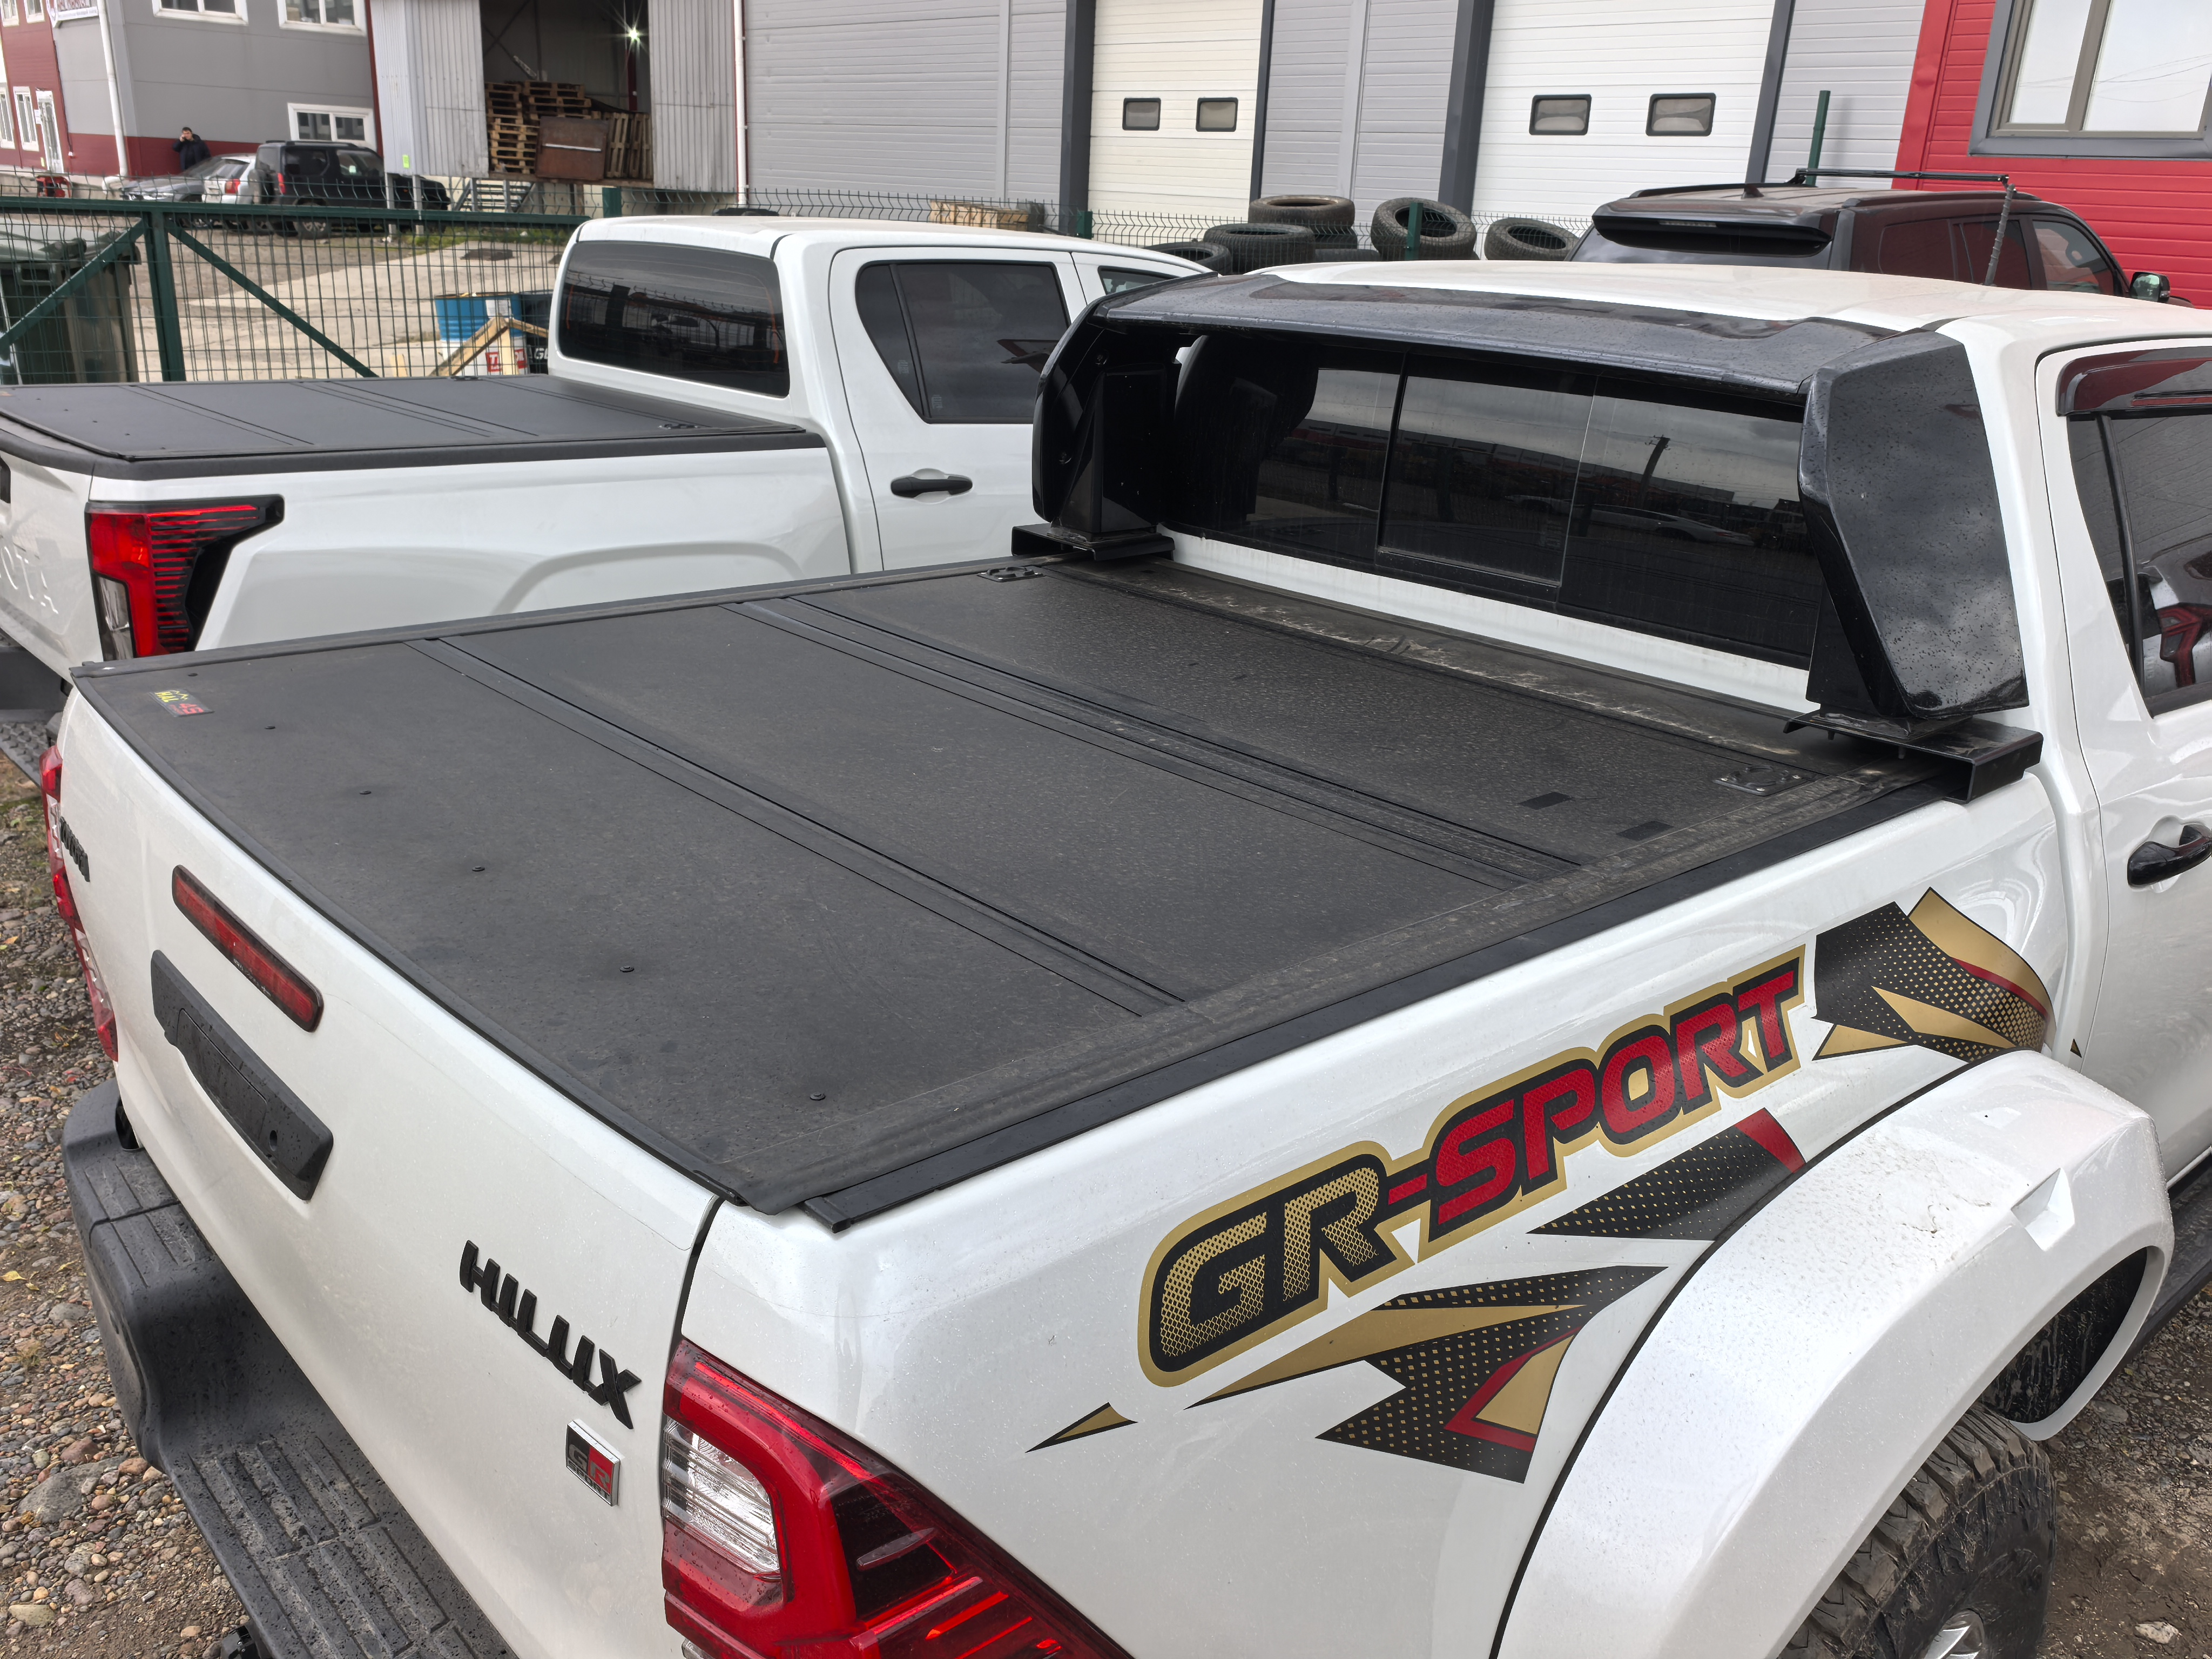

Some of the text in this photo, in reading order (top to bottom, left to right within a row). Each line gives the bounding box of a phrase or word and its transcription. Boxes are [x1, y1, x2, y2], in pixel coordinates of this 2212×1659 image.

[1149, 956, 1800, 1373] GR-SPORT
[459, 1240, 642, 1429] HILUX
[569, 1444, 611, 1492] GR
